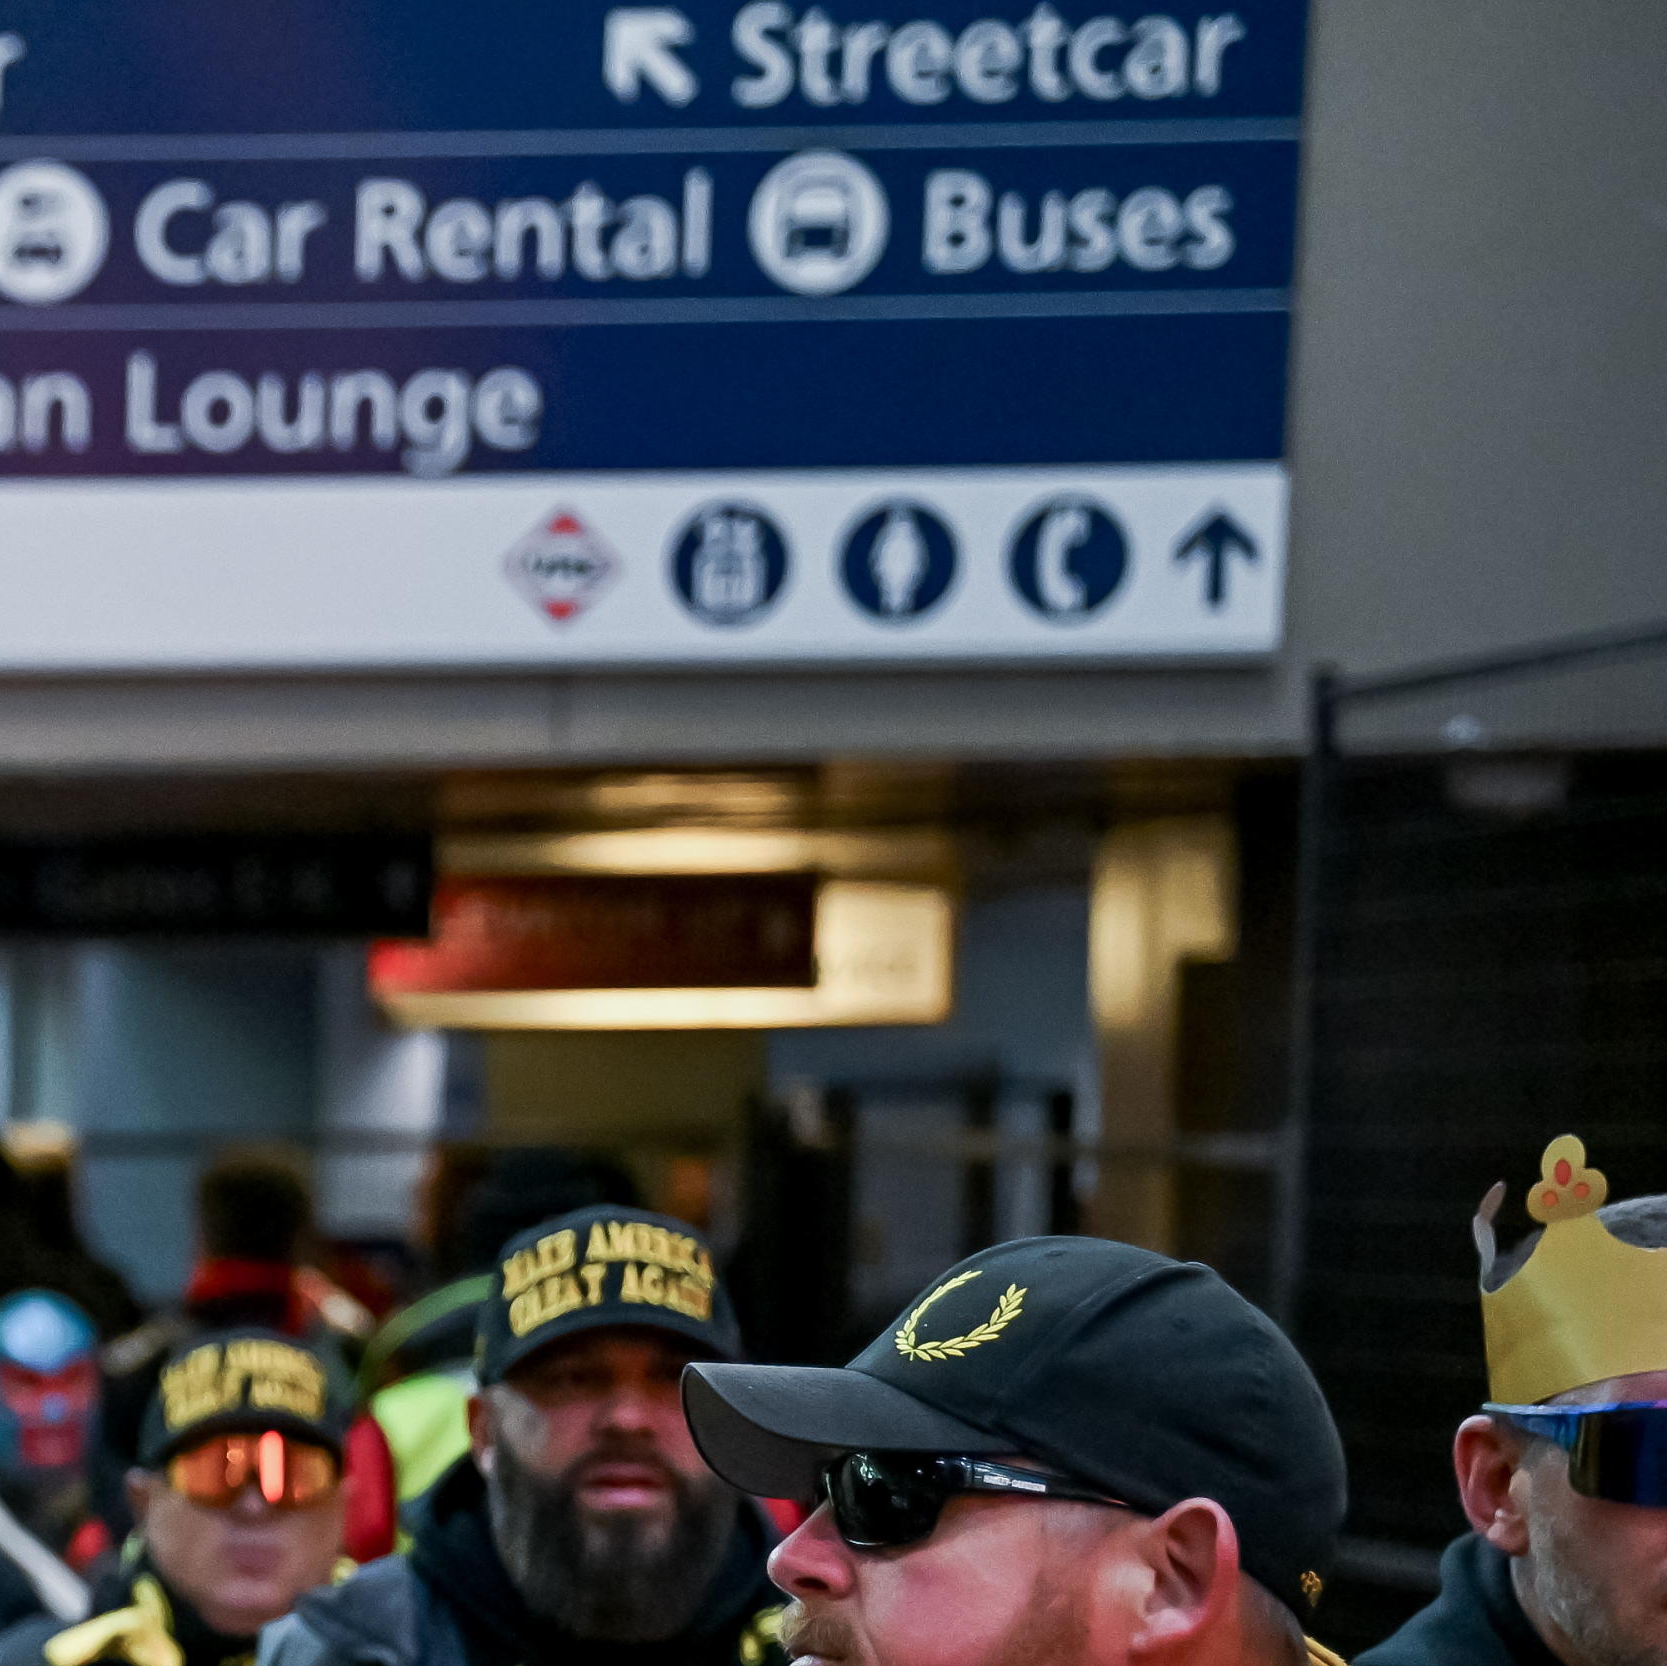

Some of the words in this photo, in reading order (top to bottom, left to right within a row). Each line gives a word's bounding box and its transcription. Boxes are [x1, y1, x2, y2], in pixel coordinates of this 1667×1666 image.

[731, 0, 1246, 108] Streetcar
[133, 178, 323, 284] Car
[355, 166, 713, 284] Rental
[922, 168, 1236, 275] Buses
[125, 350, 542, 478] Lounge
